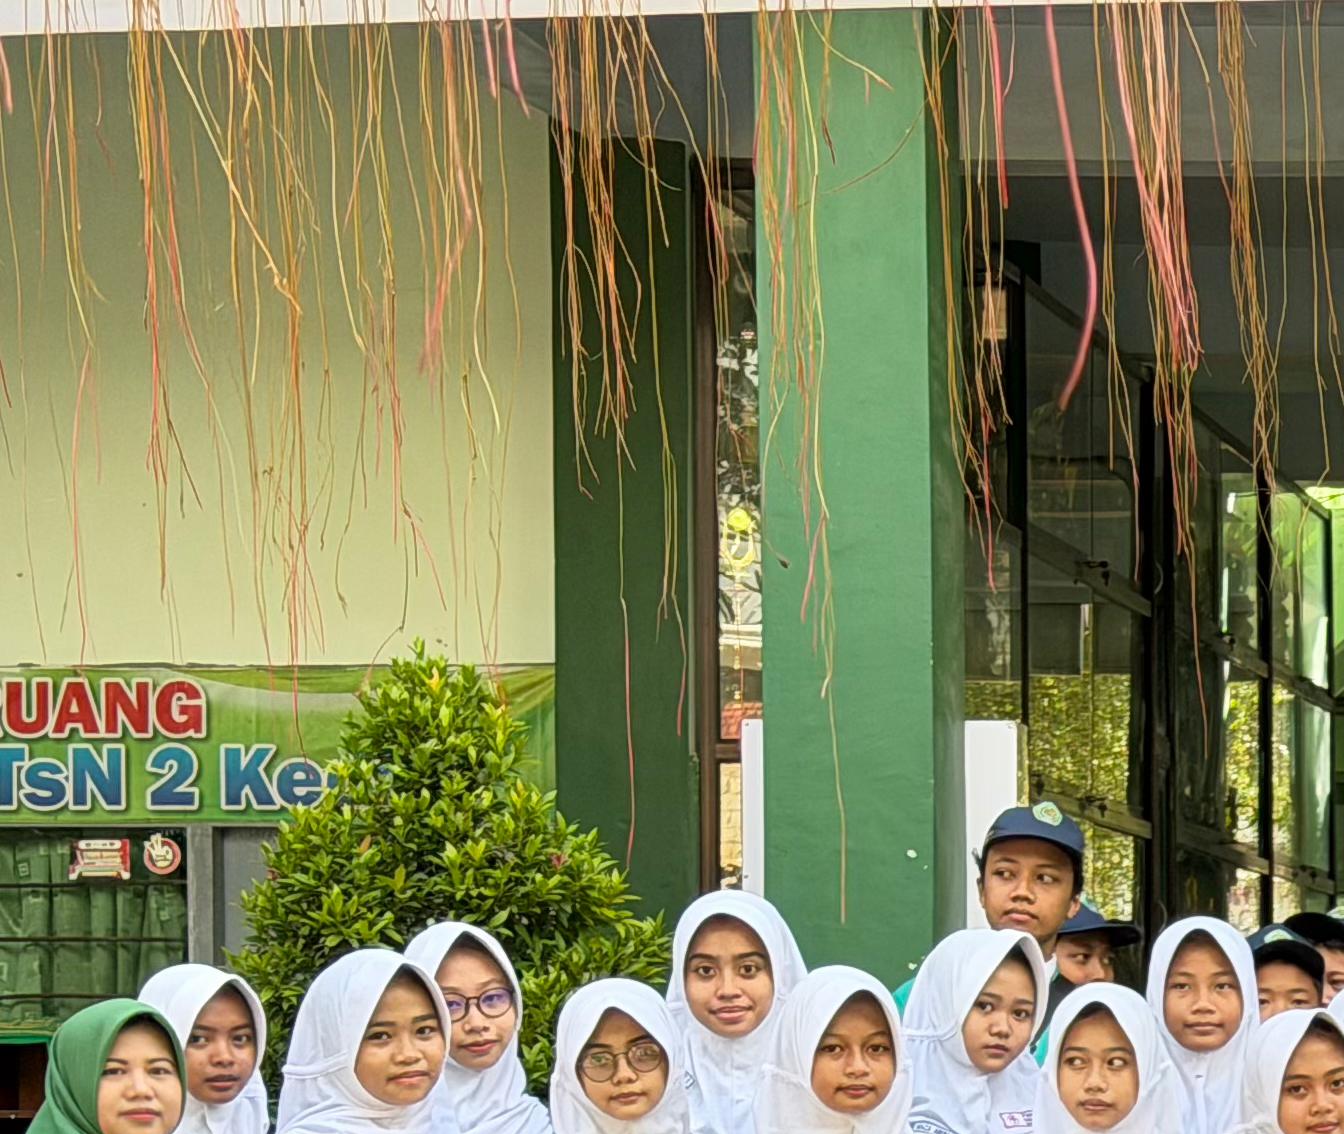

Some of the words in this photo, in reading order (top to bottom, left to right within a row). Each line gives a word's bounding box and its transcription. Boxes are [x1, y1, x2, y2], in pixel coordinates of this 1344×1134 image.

[0, 678, 207, 736] UANG
[0, 745, 125, 808] TsN
[147, 744, 199, 807] 2
[223, 746, 340, 807] Ke
